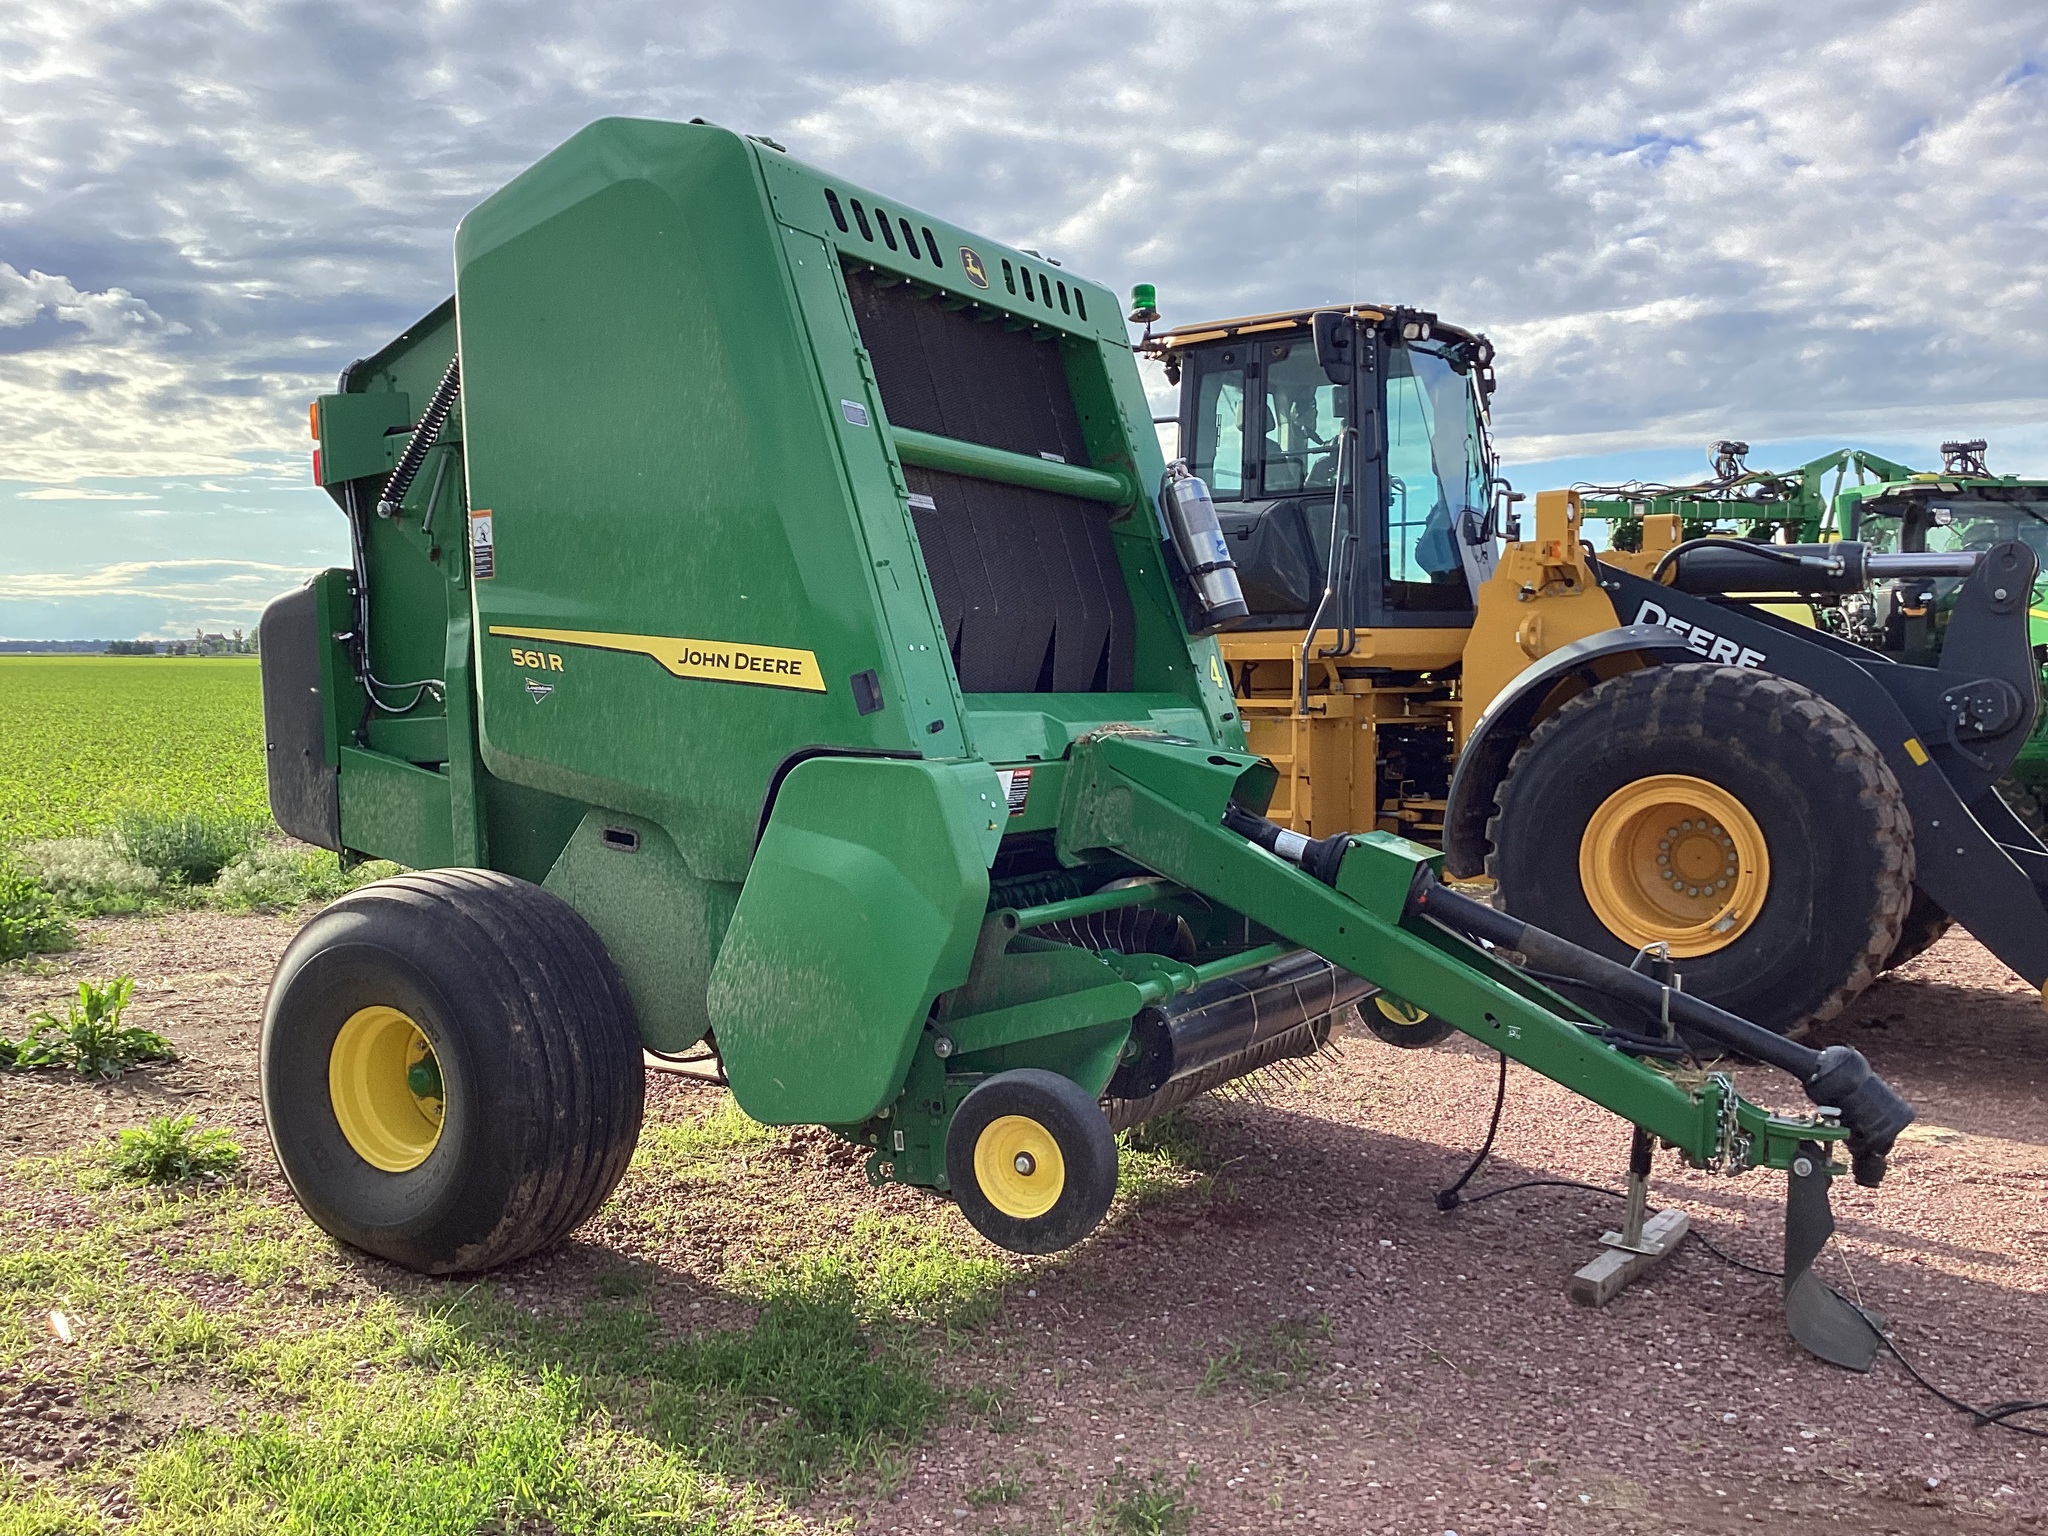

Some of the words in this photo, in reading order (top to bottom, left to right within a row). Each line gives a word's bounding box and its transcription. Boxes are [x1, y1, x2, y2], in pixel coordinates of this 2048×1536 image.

[678, 647, 729, 668] JOHN
[735, 652, 802, 676] DEERE
[1211, 655, 1223, 688] 4
